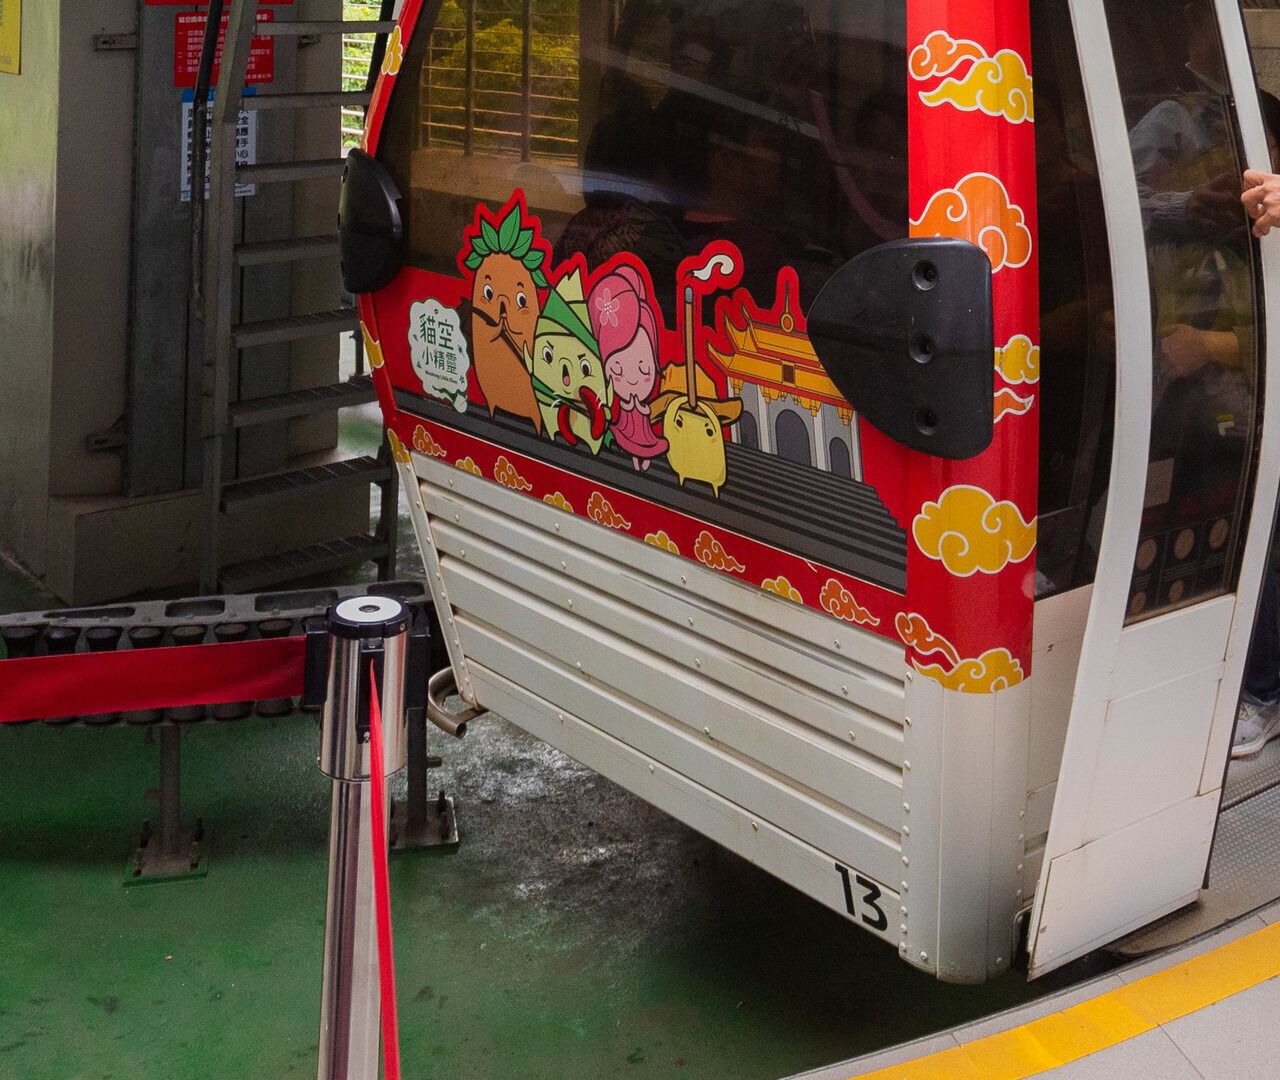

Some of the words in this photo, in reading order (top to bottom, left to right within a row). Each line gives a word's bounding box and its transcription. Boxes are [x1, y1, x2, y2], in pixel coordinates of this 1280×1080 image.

[419, 313, 455, 351] 貓空
[421, 346, 458, 376] 小精靈
[834, 861, 888, 932] 13
